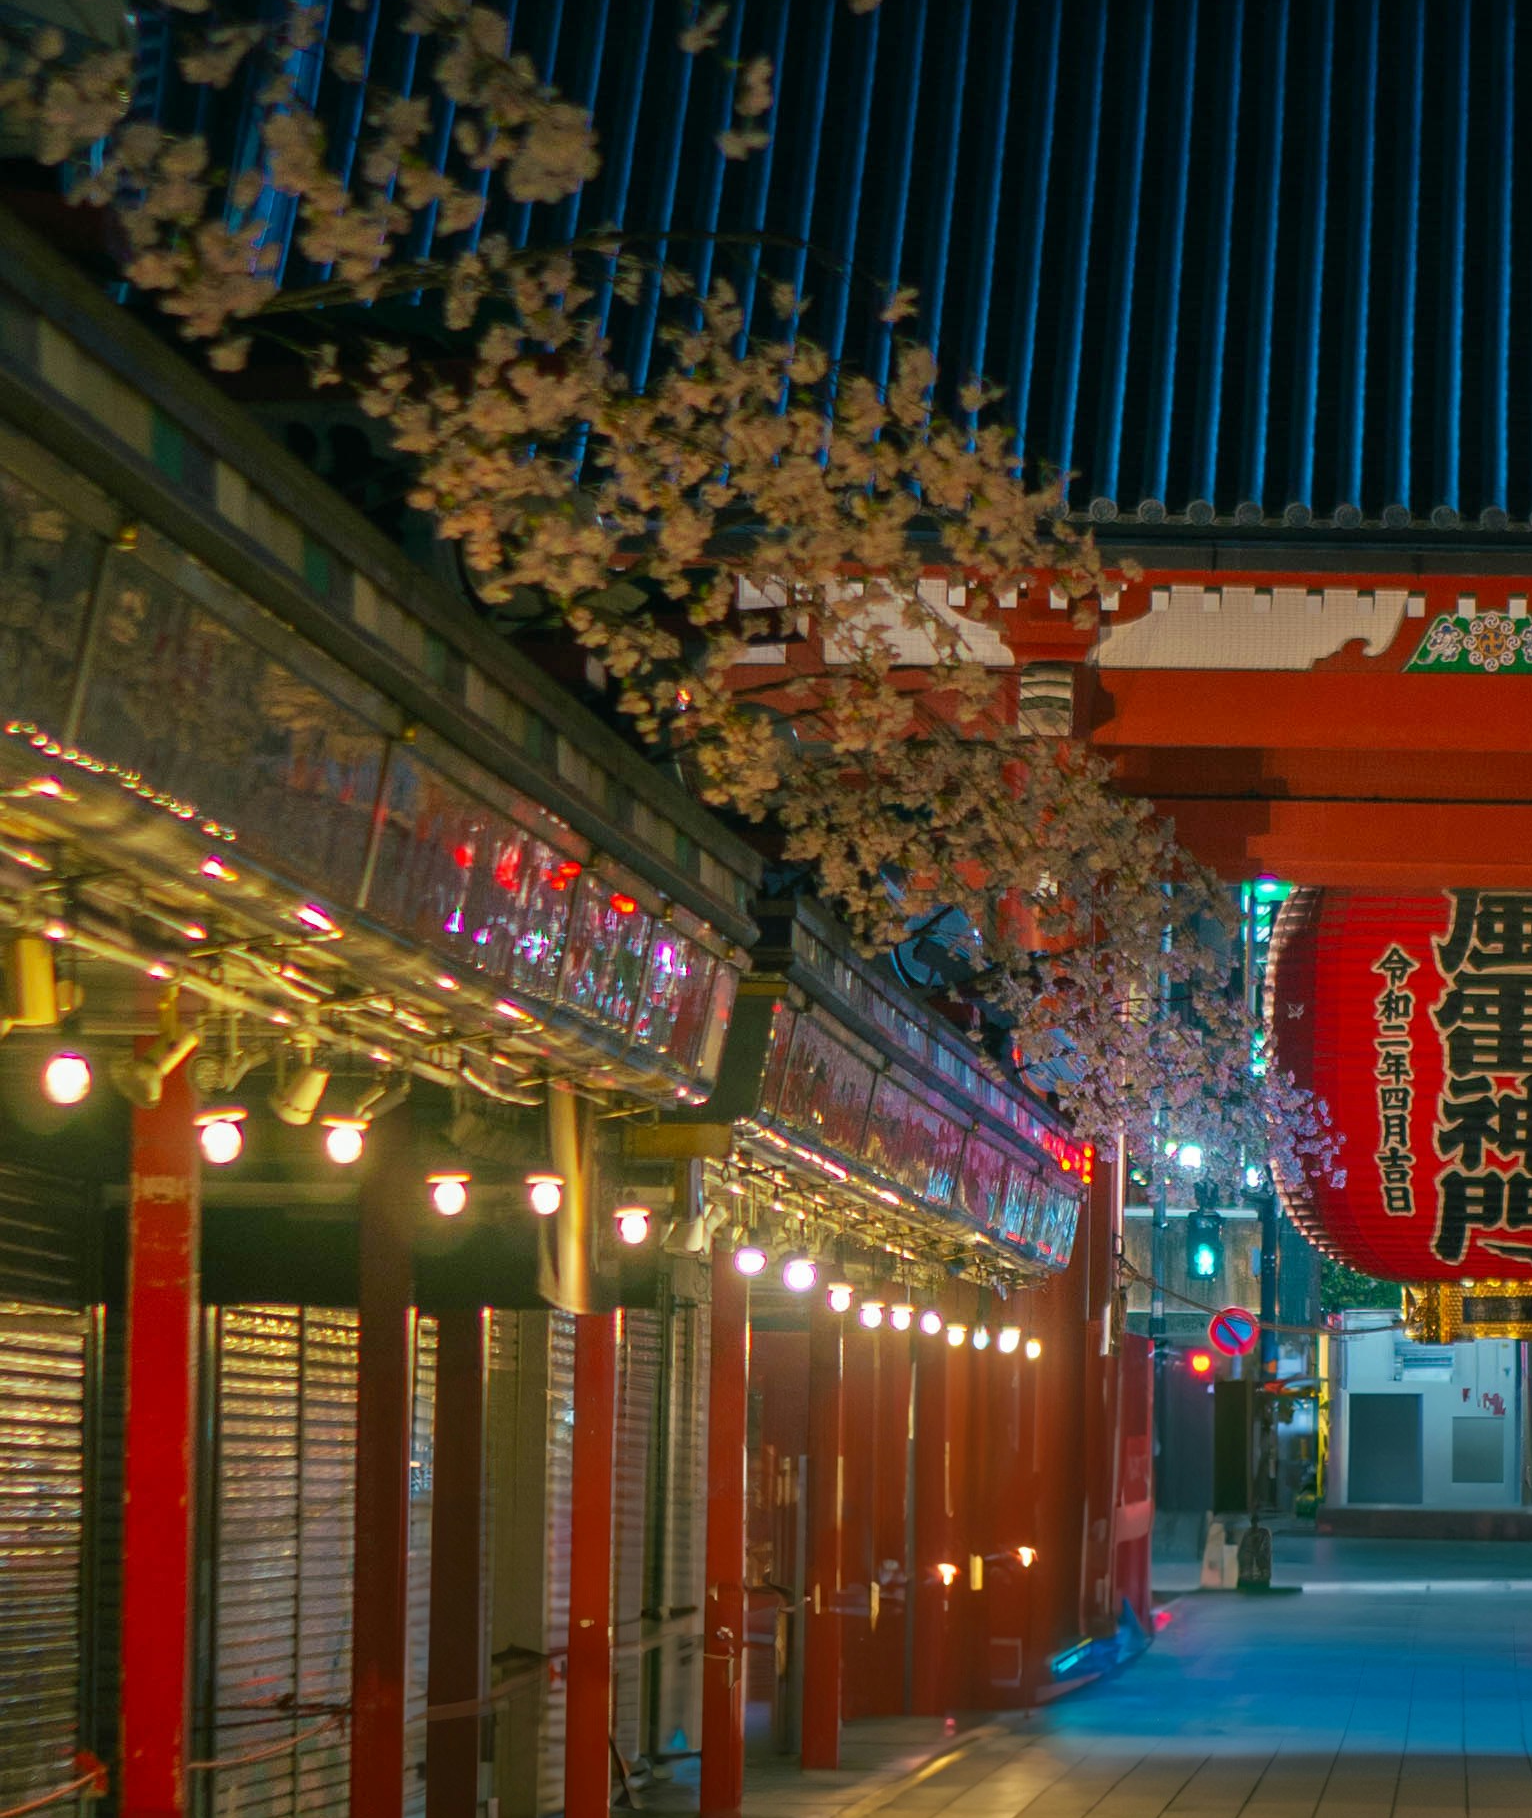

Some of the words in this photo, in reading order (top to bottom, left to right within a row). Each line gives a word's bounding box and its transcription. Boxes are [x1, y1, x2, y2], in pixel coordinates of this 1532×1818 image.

[1373, 945, 1418, 1216] 令和二年四月吉日
